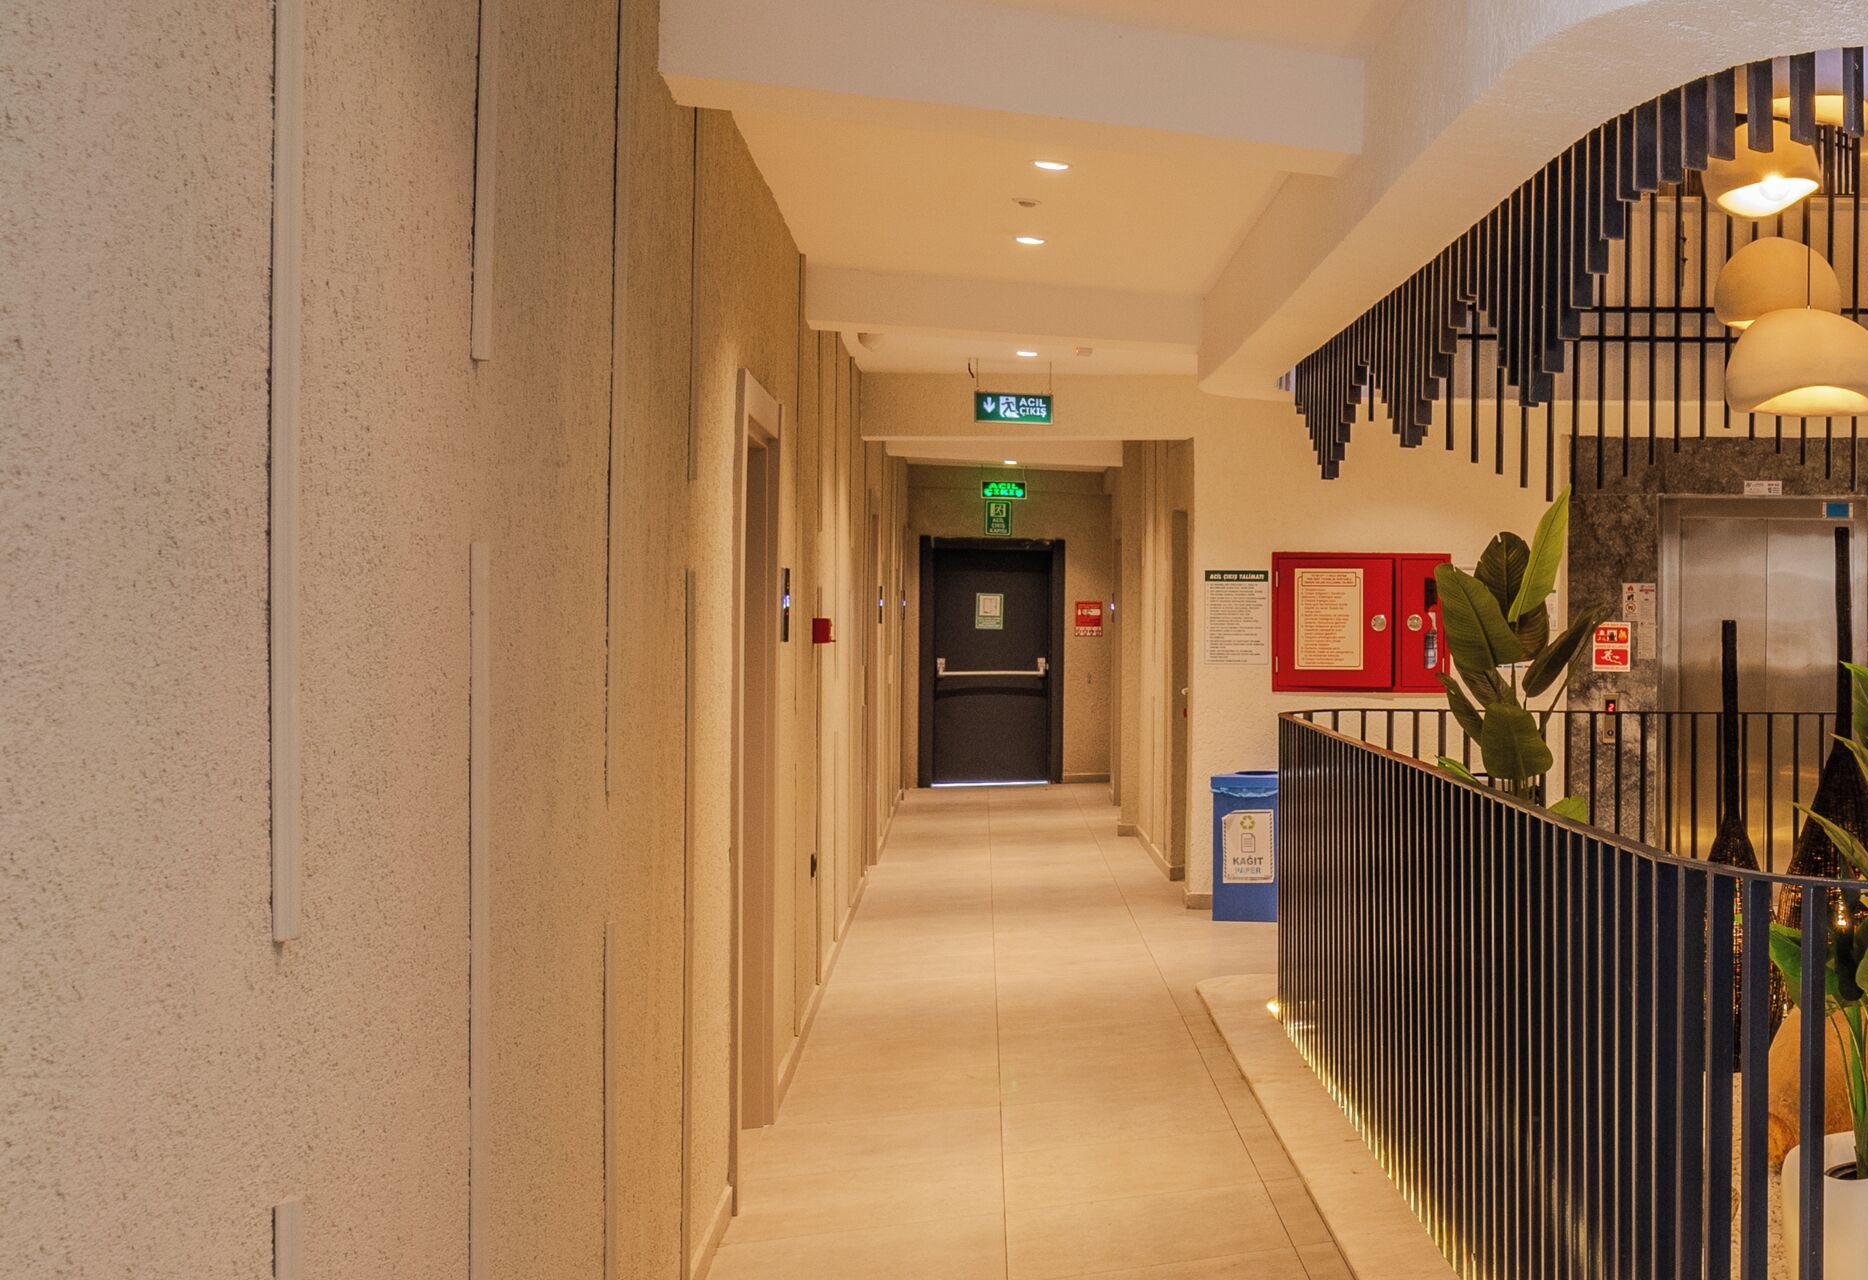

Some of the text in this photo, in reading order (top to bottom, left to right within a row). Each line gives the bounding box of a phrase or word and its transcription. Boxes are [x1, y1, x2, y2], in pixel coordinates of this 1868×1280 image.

[1019, 406, 1047, 418] ÇIKIŞ
[1232, 854, 1264, 865] KAĞIT
[1235, 866, 1262, 874] PAPER
